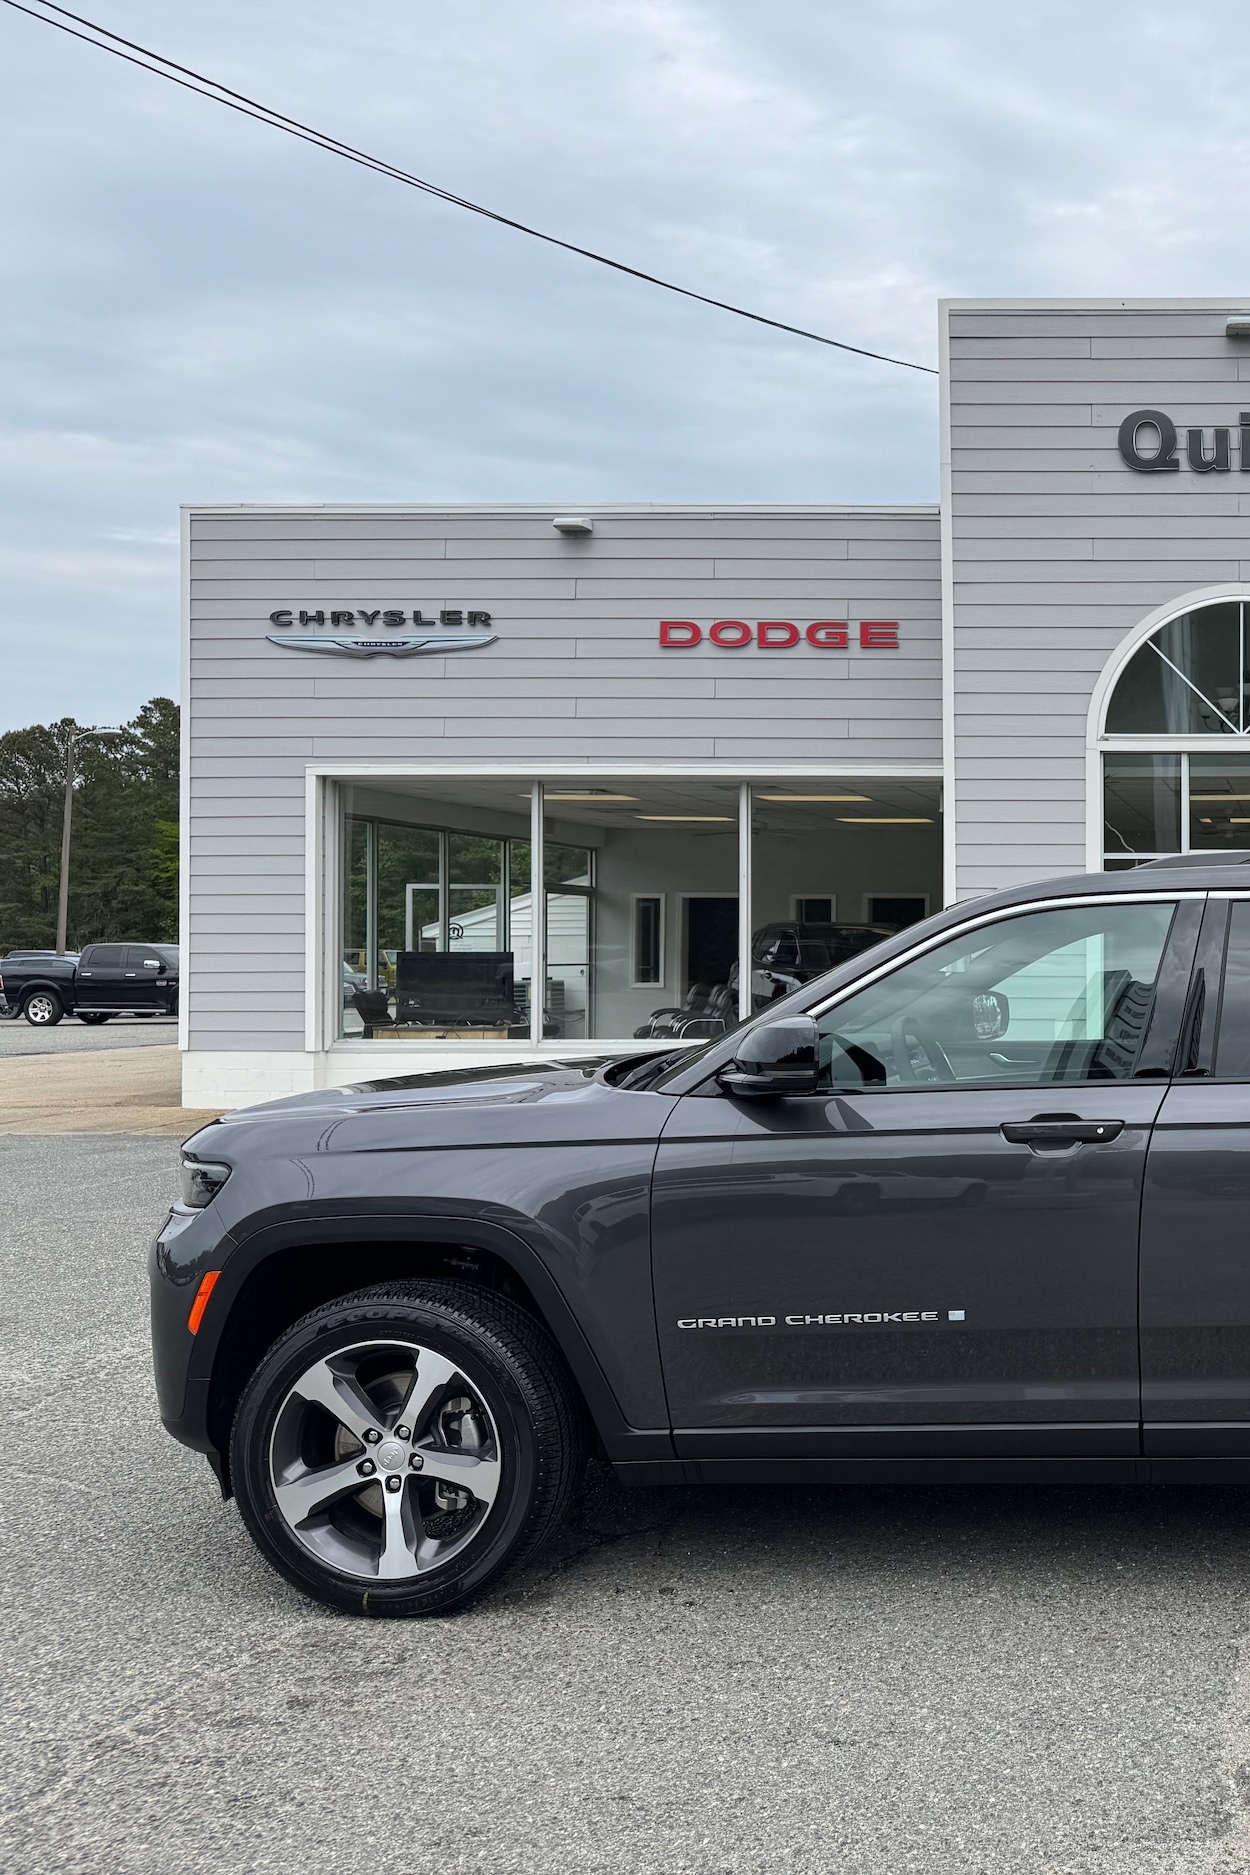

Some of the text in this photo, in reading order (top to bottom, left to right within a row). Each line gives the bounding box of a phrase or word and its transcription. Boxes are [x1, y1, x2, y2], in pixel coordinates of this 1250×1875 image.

[268, 609, 494, 627] CHRYSLER
[658, 620, 900, 649] DODGE
[677, 1311, 939, 1329] GRAND CHEROKEE
[383, 1446, 399, 1466] Jeep
